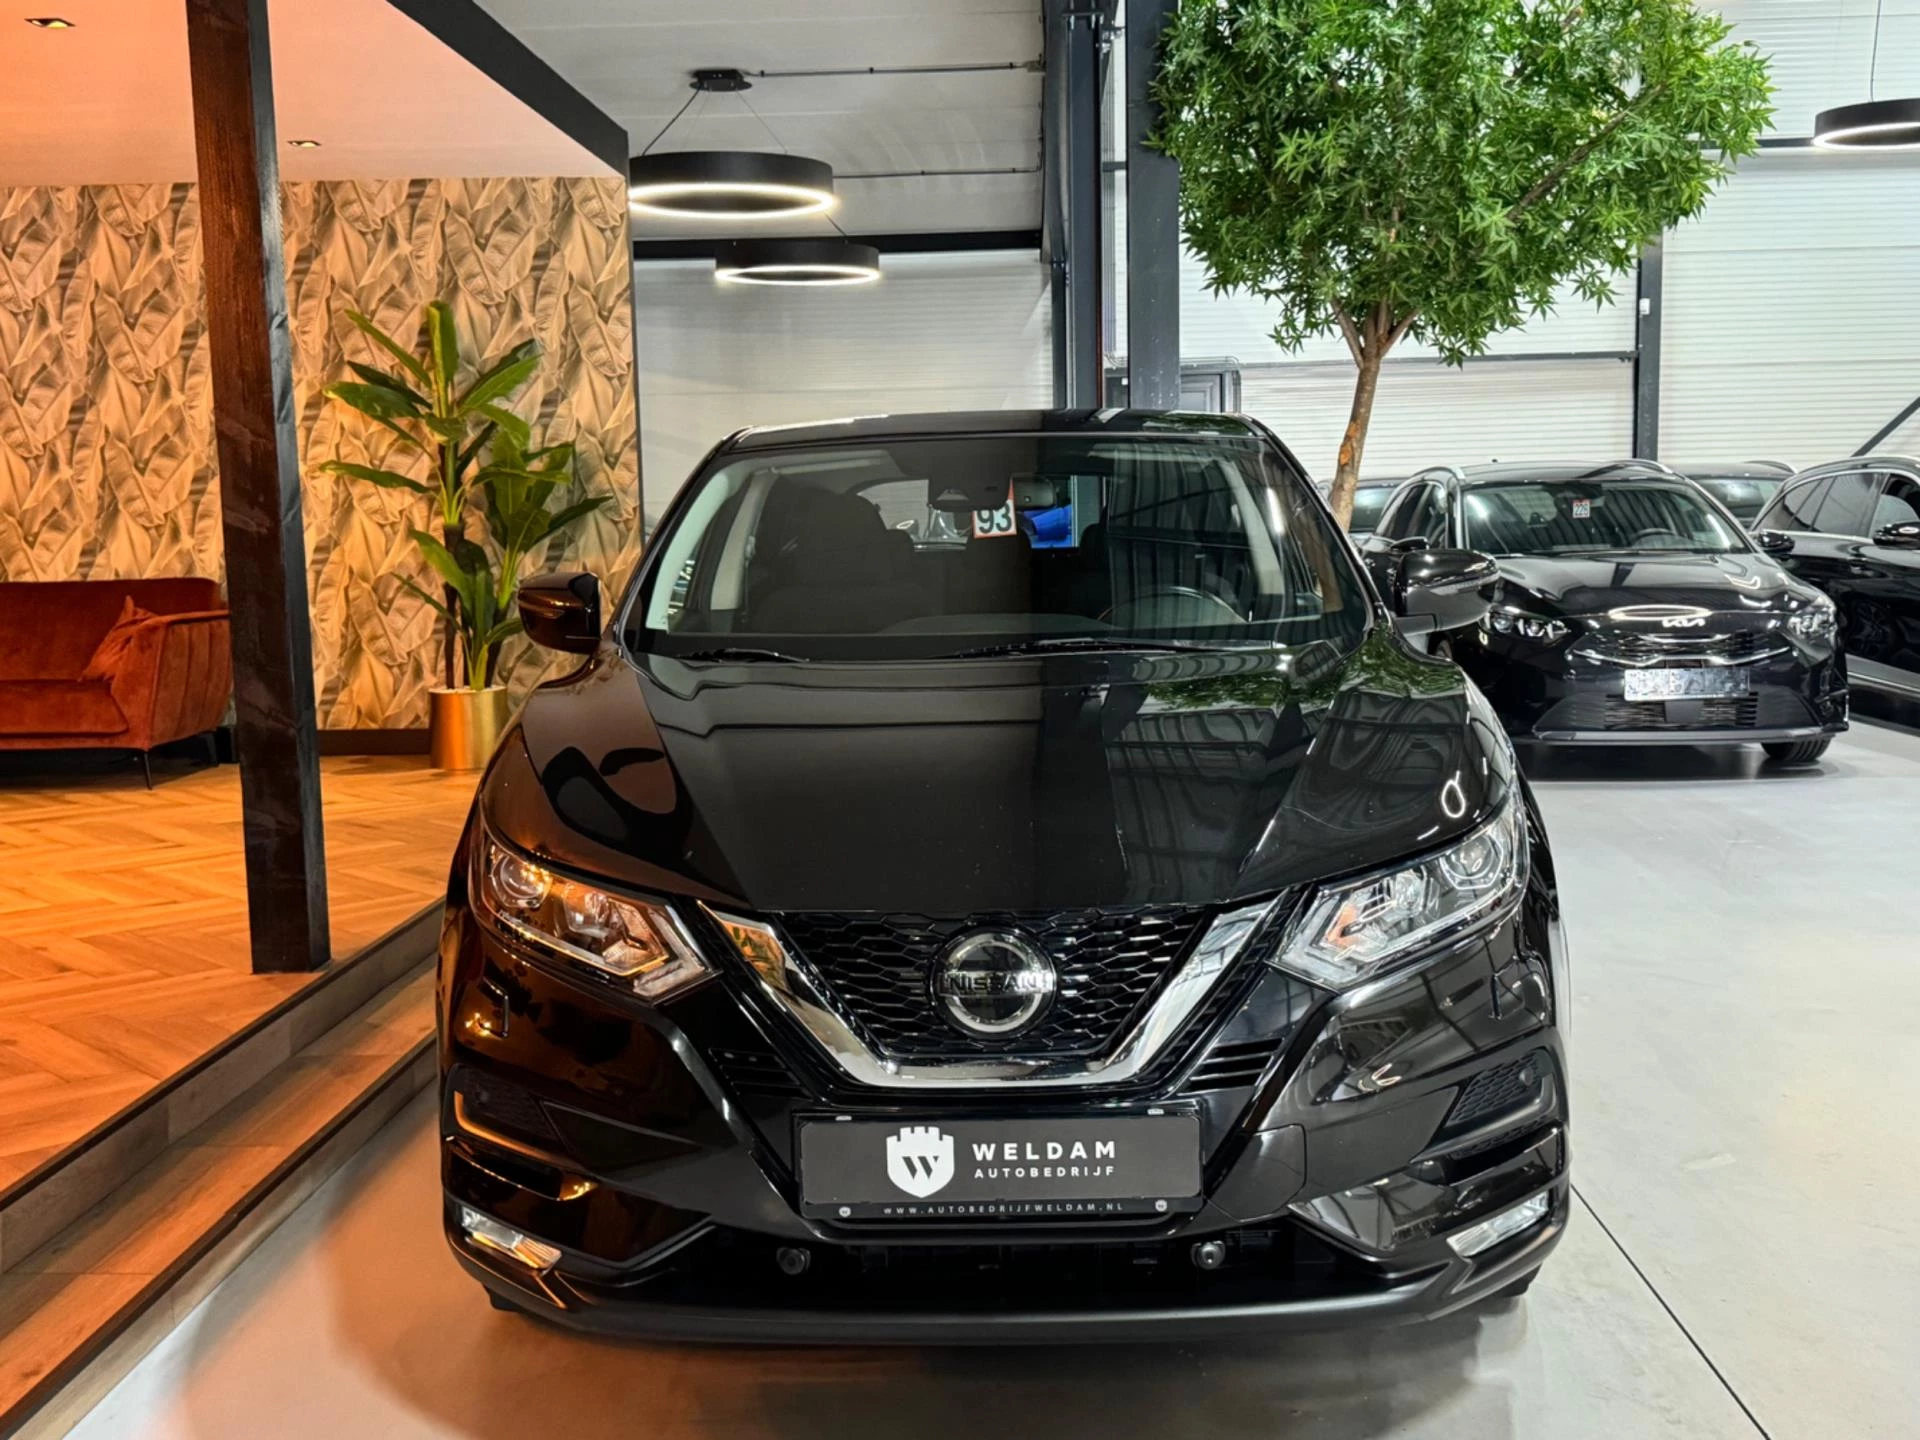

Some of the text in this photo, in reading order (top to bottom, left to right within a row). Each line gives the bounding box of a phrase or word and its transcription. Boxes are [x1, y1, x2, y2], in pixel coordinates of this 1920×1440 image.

[977, 503, 1012, 533] 93
[972, 1141, 1116, 1161] WELDAM
[974, 1166, 1116, 1179] AUTOBEDRIJF
[884, 1203, 1124, 1215] WWW.AUTOBEDRIJFWELDAM.NL
